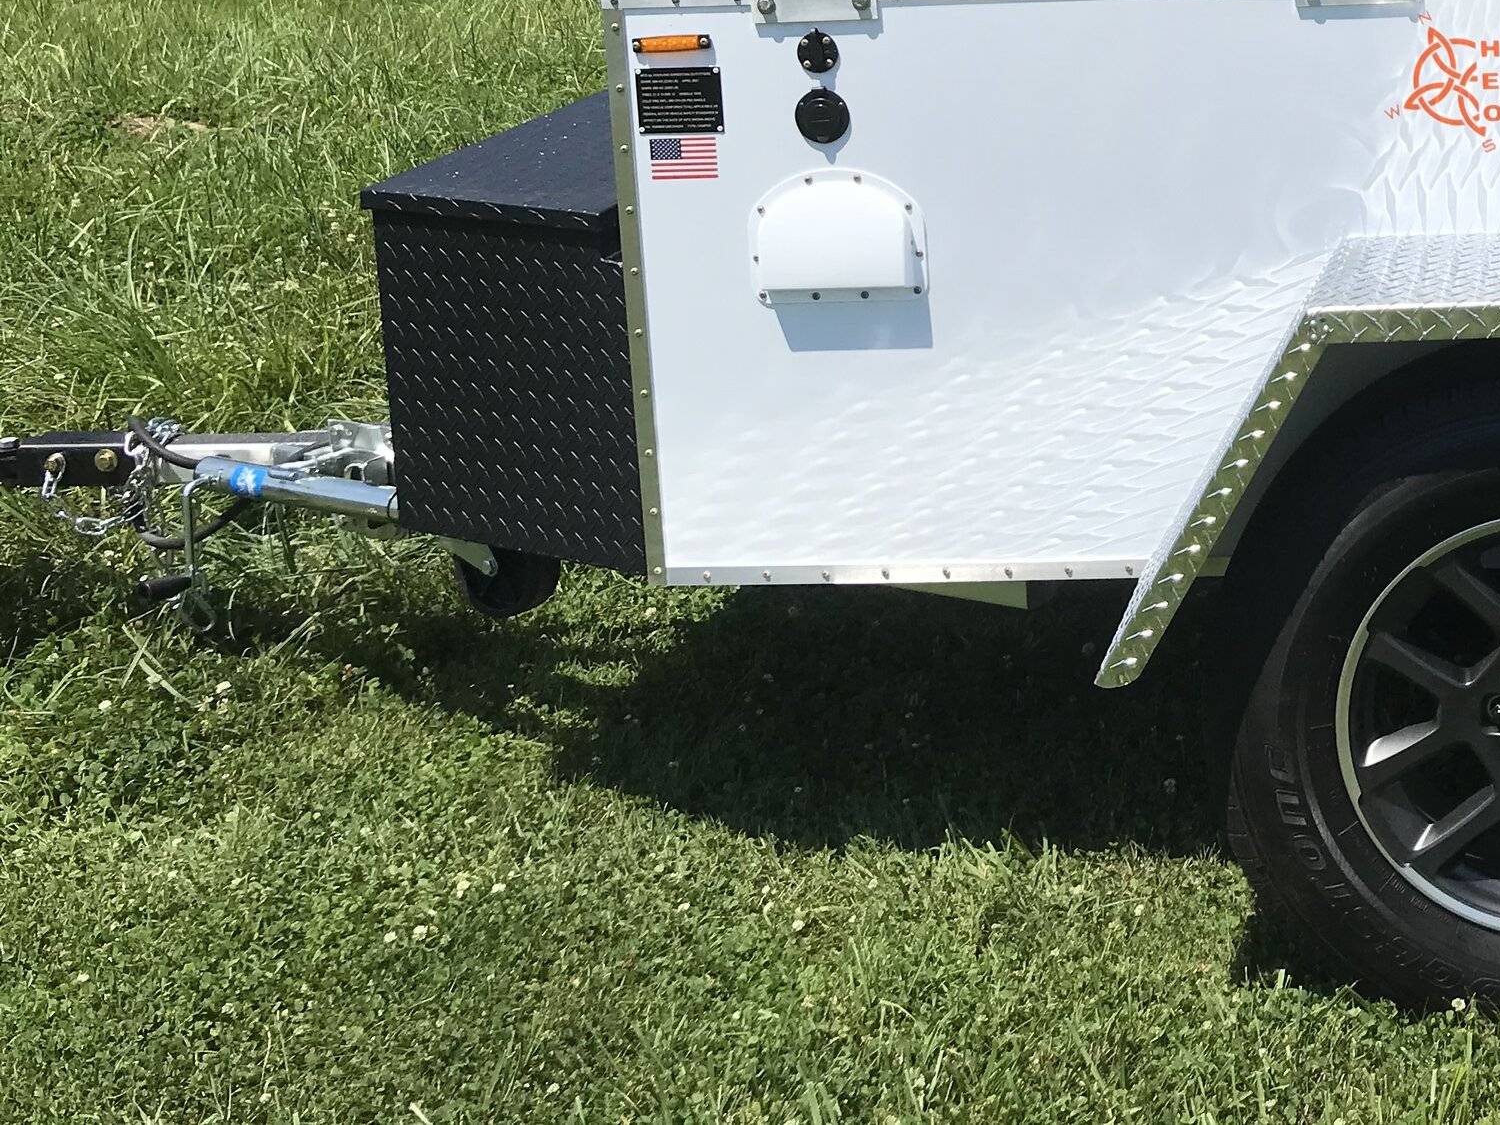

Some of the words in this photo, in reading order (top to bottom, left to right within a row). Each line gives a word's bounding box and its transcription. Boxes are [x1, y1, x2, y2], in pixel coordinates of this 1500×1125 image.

[1418, 11, 1432, 24] N
[1385, 104, 1400, 119] W
[1482, 139, 1496, 153] S
